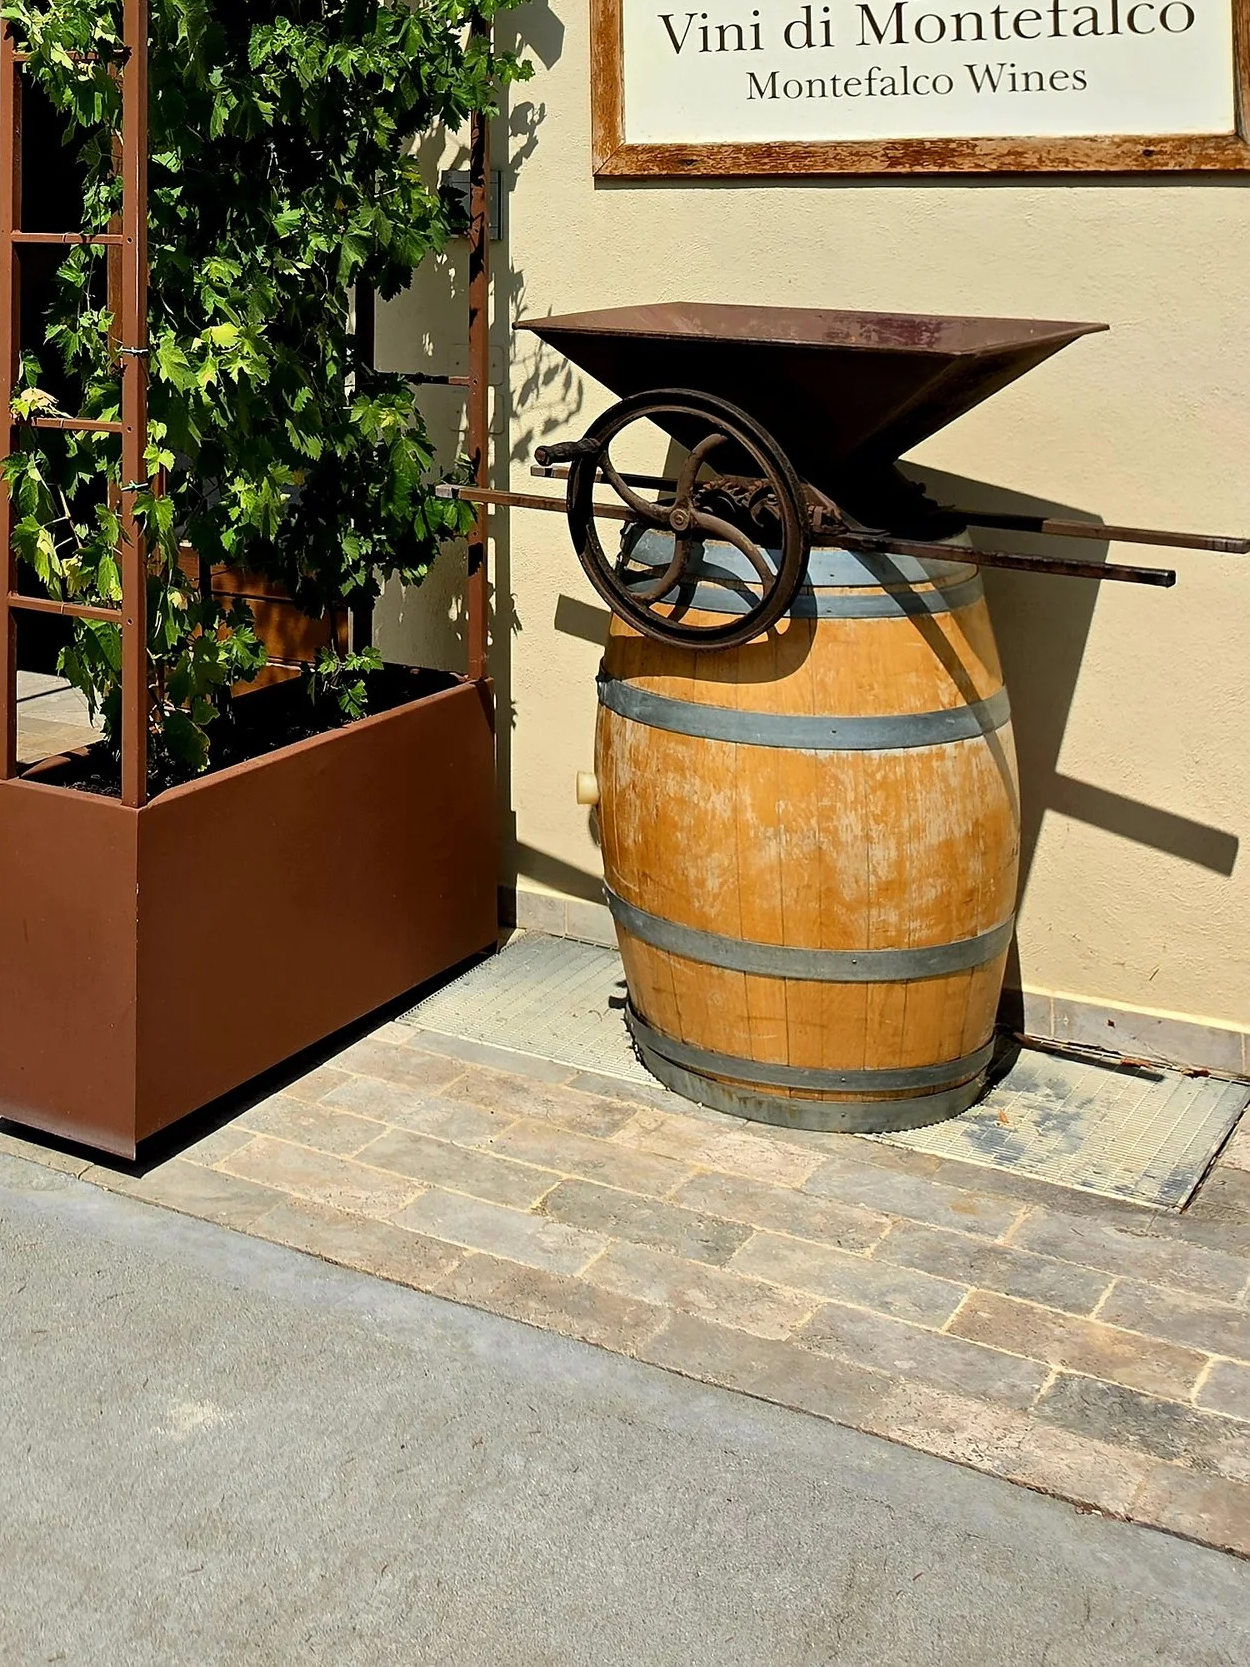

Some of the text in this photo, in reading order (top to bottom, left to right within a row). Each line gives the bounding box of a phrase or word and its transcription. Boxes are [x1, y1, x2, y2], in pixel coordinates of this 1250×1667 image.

[657, 9, 765, 55] Vini
[783, 4, 835, 50] di
[745, 62, 1088, 101] Montefalco Wines
